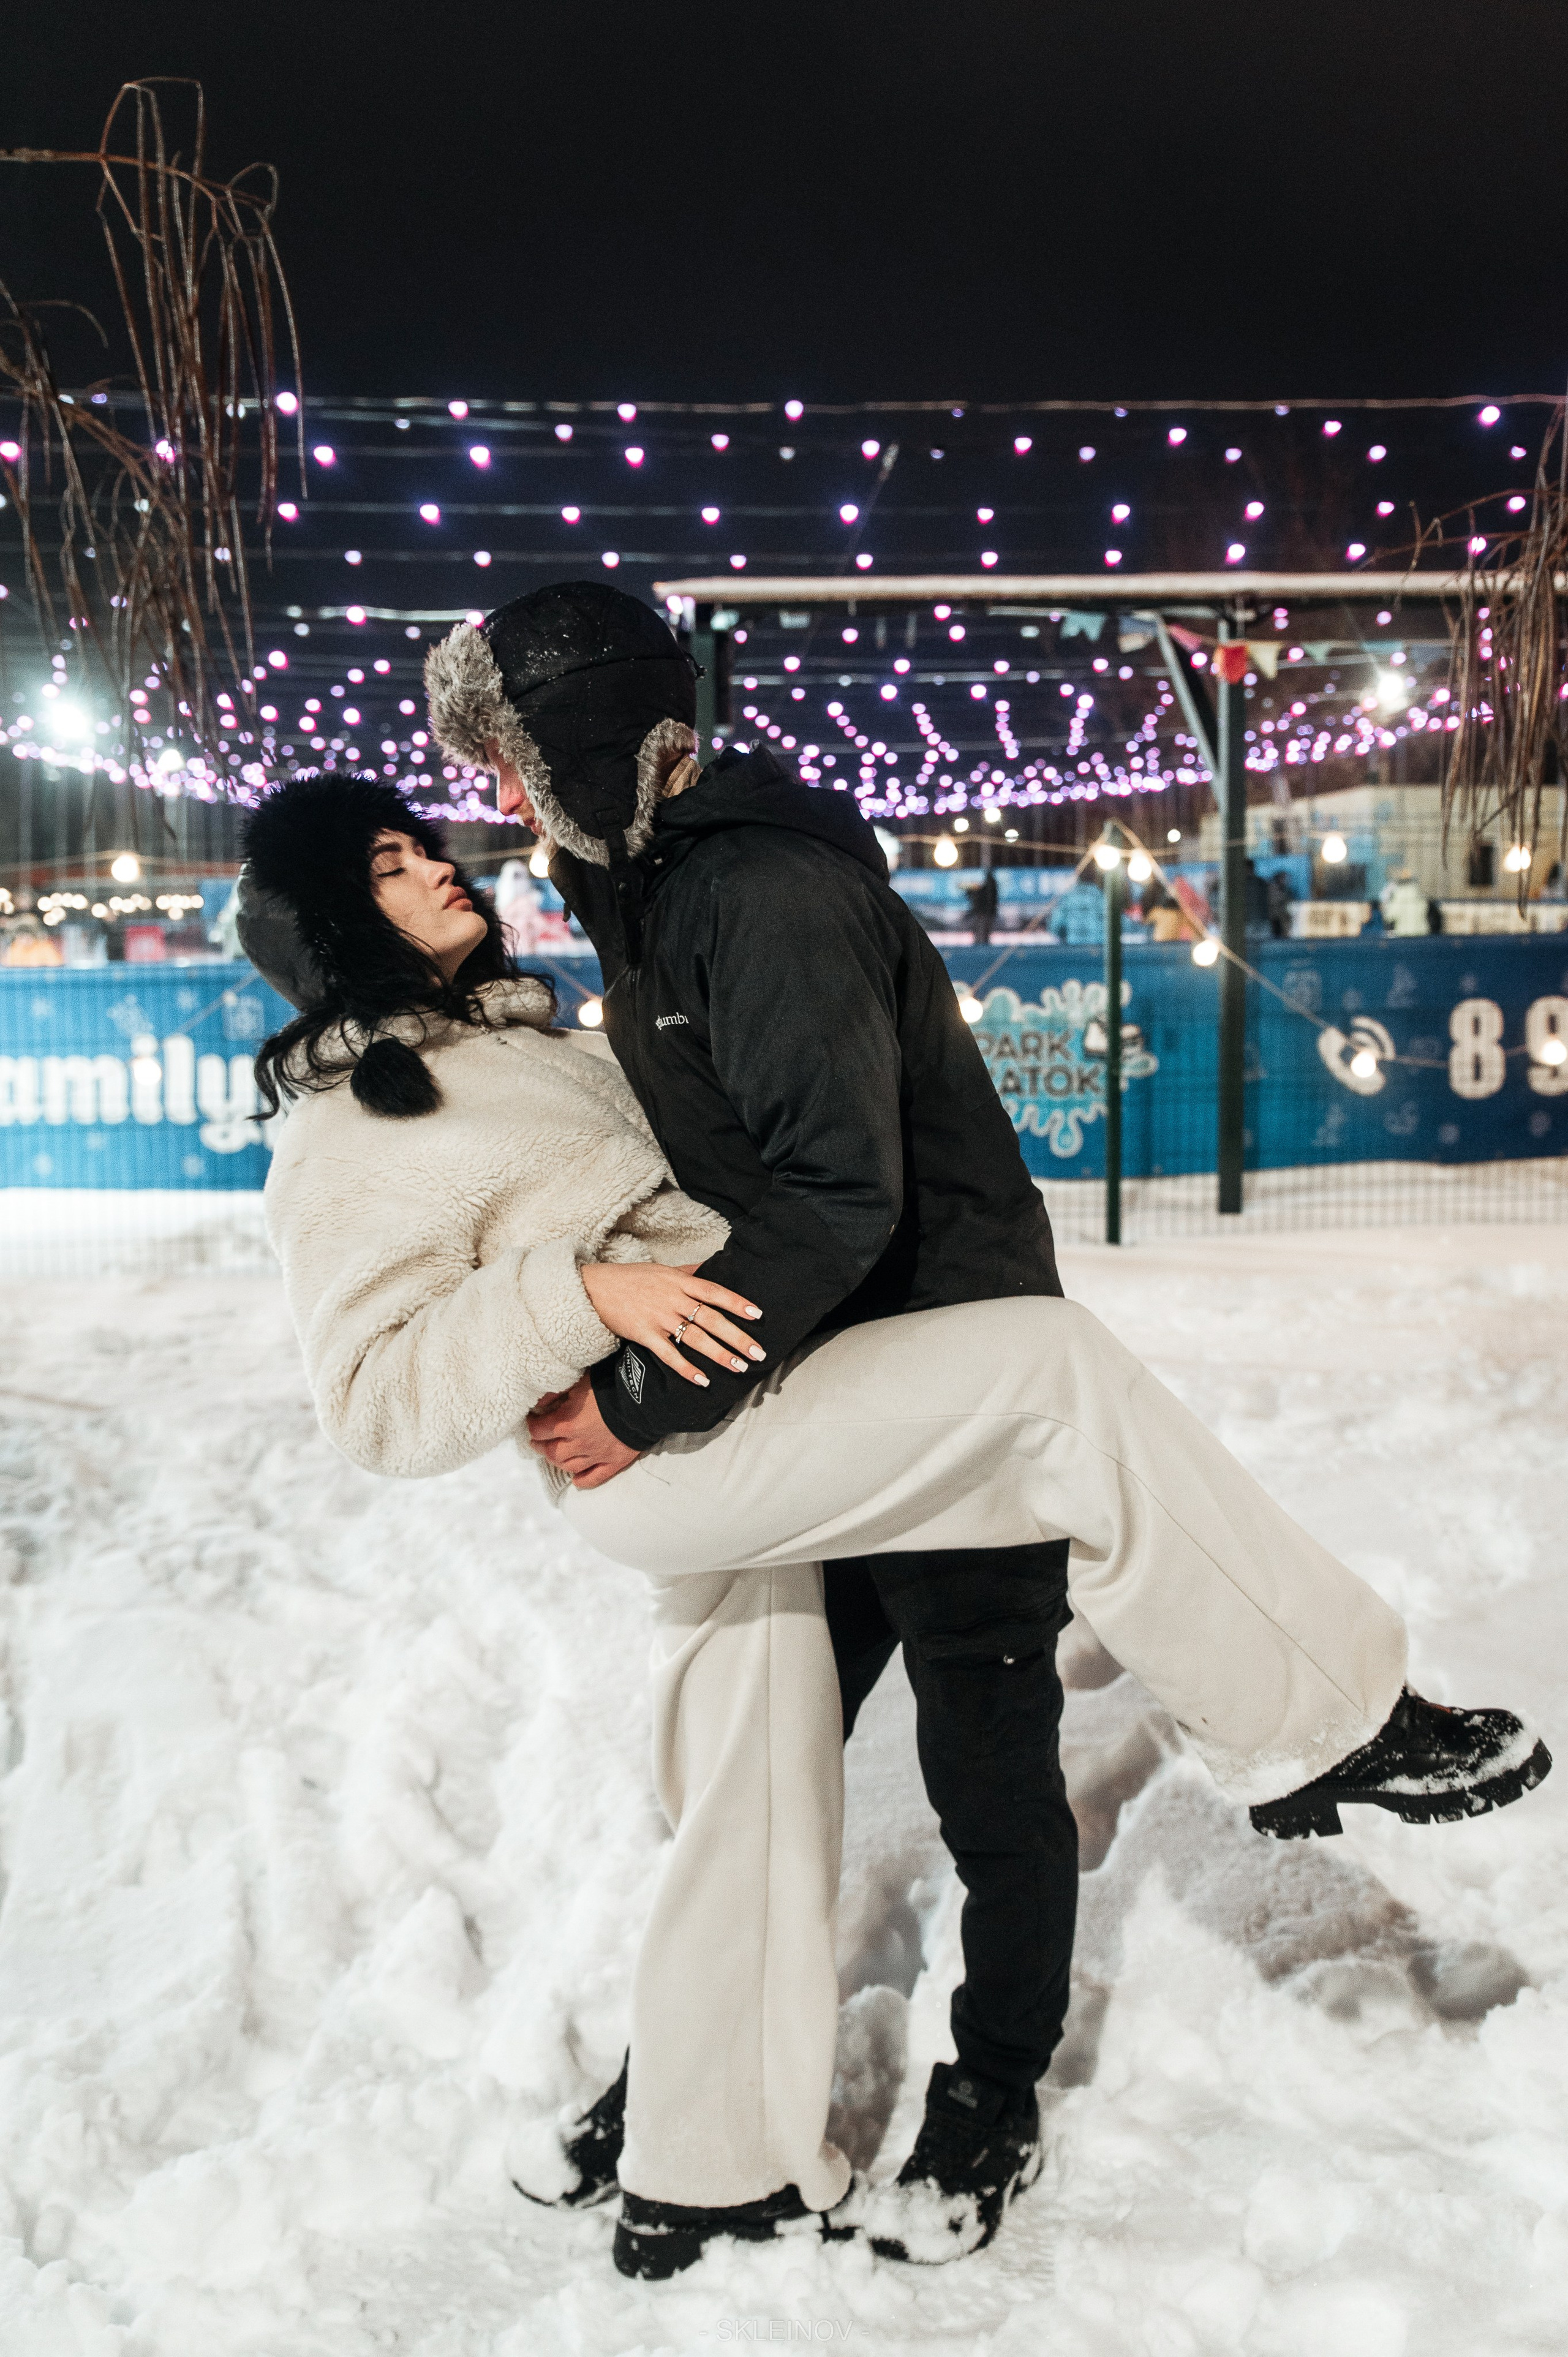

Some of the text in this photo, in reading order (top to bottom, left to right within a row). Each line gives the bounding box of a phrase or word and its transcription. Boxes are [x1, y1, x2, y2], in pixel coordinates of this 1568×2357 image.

[0, 1033, 283, 1154] amily
[990, 1065, 1101, 1098] ATOK
[1449, 998, 1506, 1099] 8
